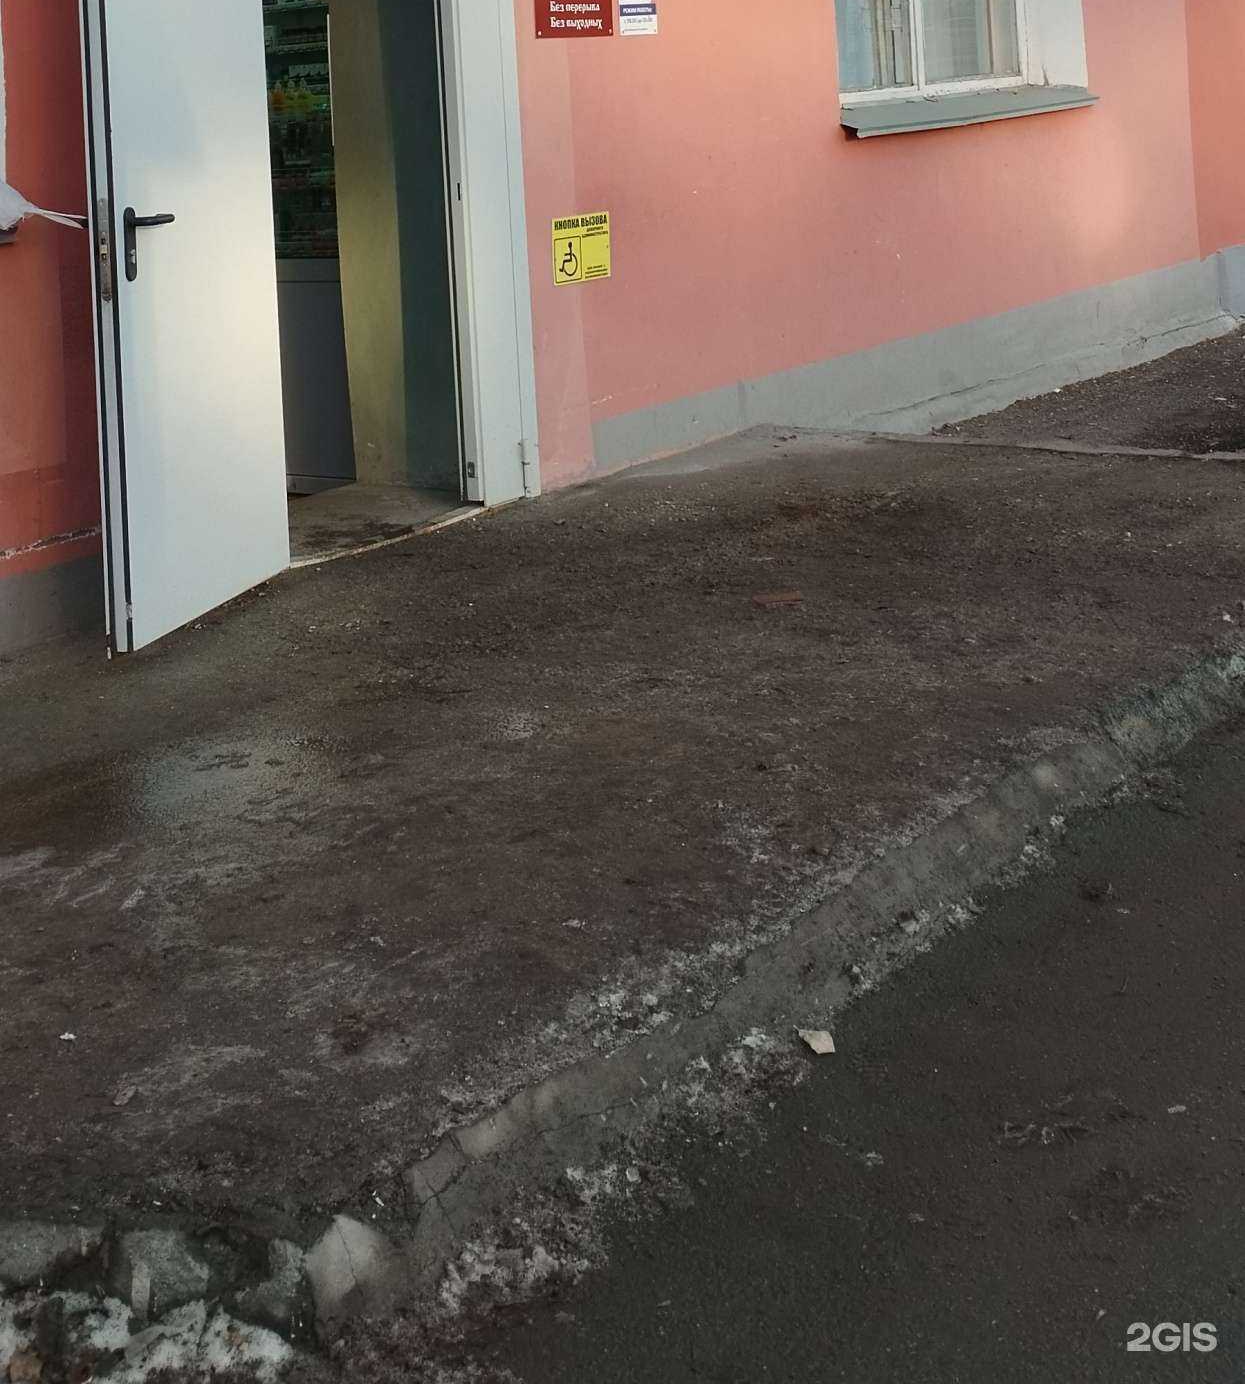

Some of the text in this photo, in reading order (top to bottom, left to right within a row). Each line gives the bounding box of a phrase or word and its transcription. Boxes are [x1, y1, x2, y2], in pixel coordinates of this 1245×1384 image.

[549, 0, 600, 15] Без перерыва
[550, 16, 602, 30] Без выходных
[554, 218, 580, 231] КНОПКА
[581, 214, 608, 228] ВЫЗОВА
